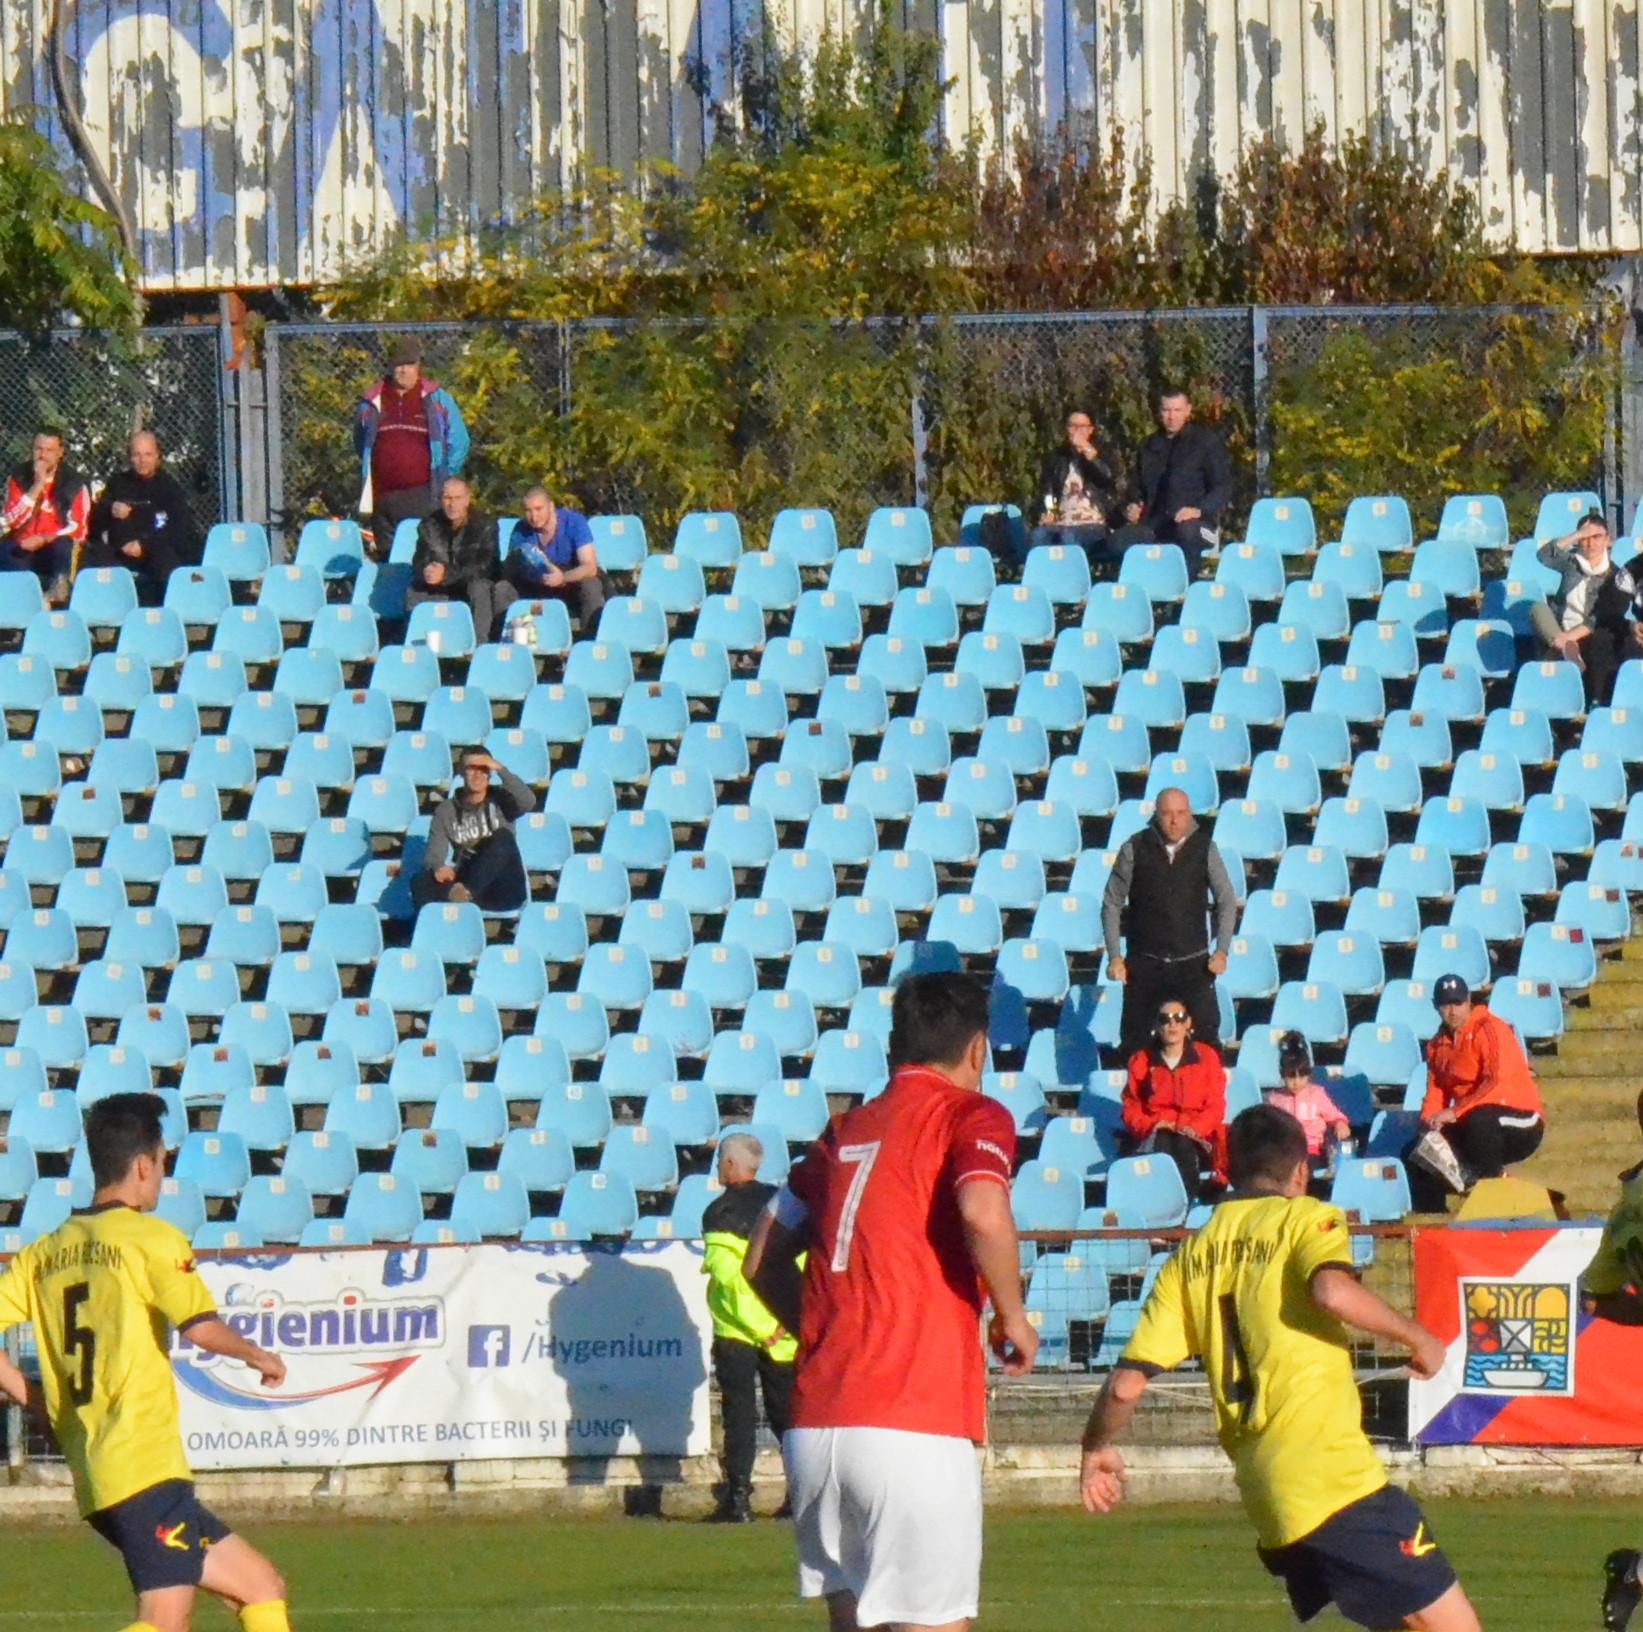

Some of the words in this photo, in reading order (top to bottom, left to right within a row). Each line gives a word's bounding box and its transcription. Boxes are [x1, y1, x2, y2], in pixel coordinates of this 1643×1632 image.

[830, 1140, 882, 1273] 7
[64, 1281, 96, 1408] 5
[187, 1426, 288, 1451] OMOARĂ
[295, 1428, 340, 1448] 99%
[346, 1424, 428, 1446] DINTRE
[435, 1421, 531, 1441] BACTERII
[566, 1418, 635, 1439] FUNGI
